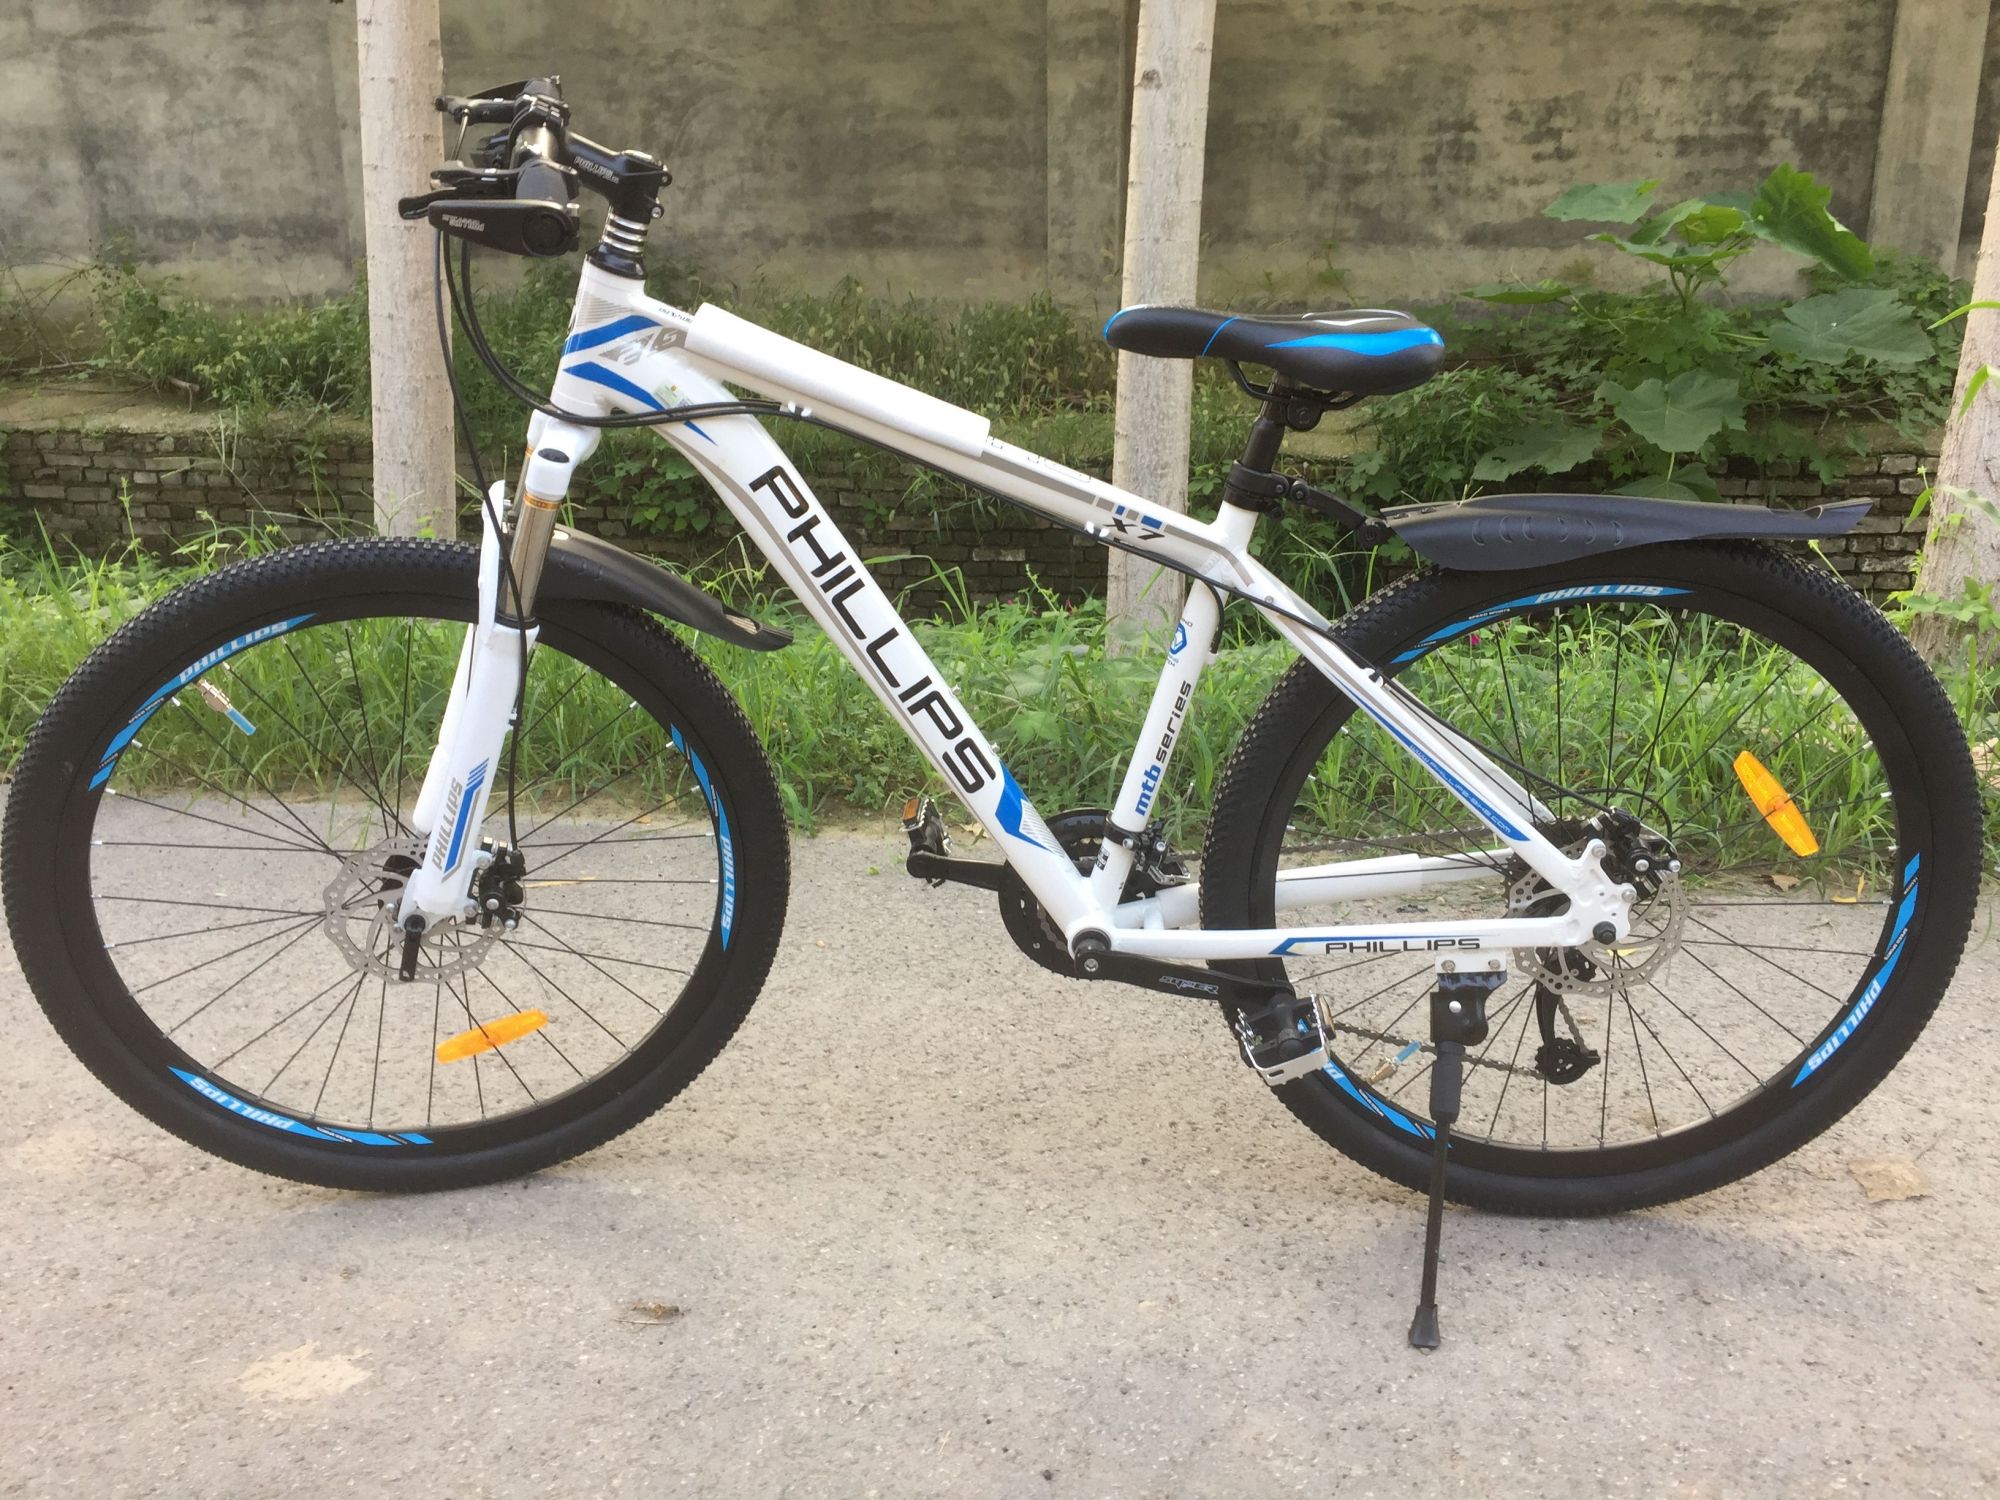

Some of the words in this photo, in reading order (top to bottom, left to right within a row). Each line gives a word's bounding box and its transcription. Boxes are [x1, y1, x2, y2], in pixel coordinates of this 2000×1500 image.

[748, 465, 997, 794] PHILLIPS
[1534, 583, 1665, 604] PHILLIPS
[178, 620, 288, 684] PHILLIPS
[1135, 763, 1162, 816] mtb
[1155, 680, 1192, 764] series
[431, 776, 463, 871] PHILLIPS
[719, 834, 736, 930] PHILLIPS
[1326, 937, 1481, 955] PHILLIPS
[1807, 977, 1882, 1072] PHILLIPS
[189, 1076, 297, 1131] PHILLIPS
